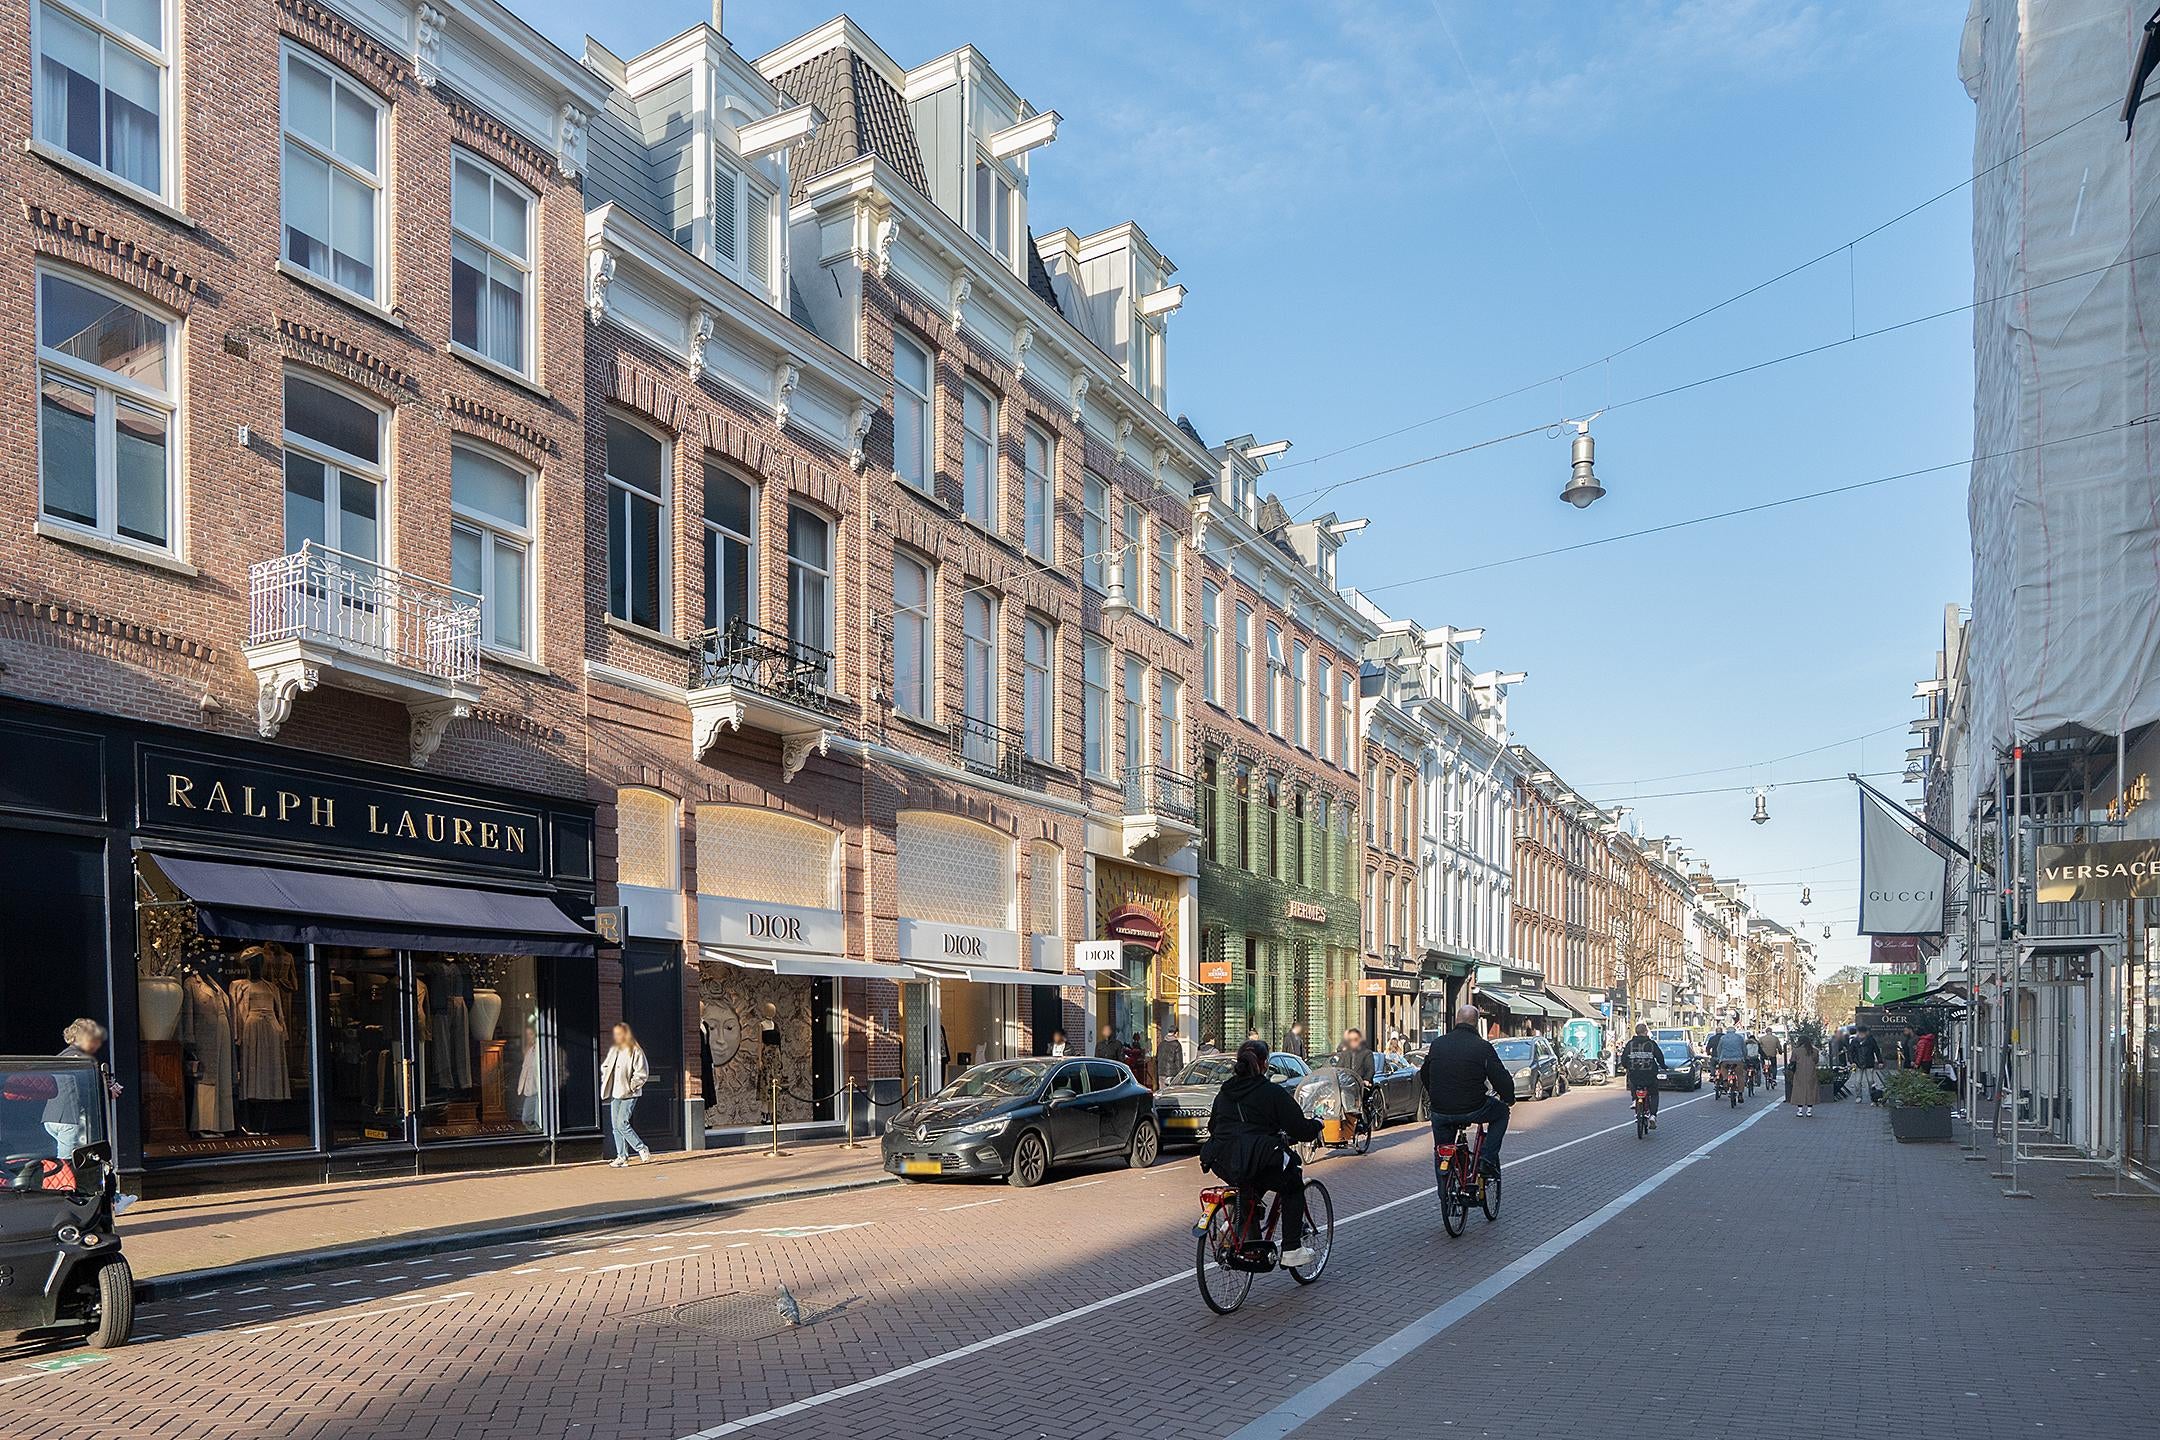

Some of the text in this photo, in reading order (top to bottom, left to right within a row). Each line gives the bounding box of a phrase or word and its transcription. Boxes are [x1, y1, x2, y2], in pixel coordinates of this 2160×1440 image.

[166, 773, 525, 854] RALPH LAUREN
[2045, 861, 2160, 881] VERSACE
[1869, 890, 1934, 902] GUCCI
[746, 912, 802, 942] DIOR
[943, 932, 983, 957] DIOR
[1085, 949, 1115, 961] DIOR
[167, 1142, 217, 1153] RALPH
